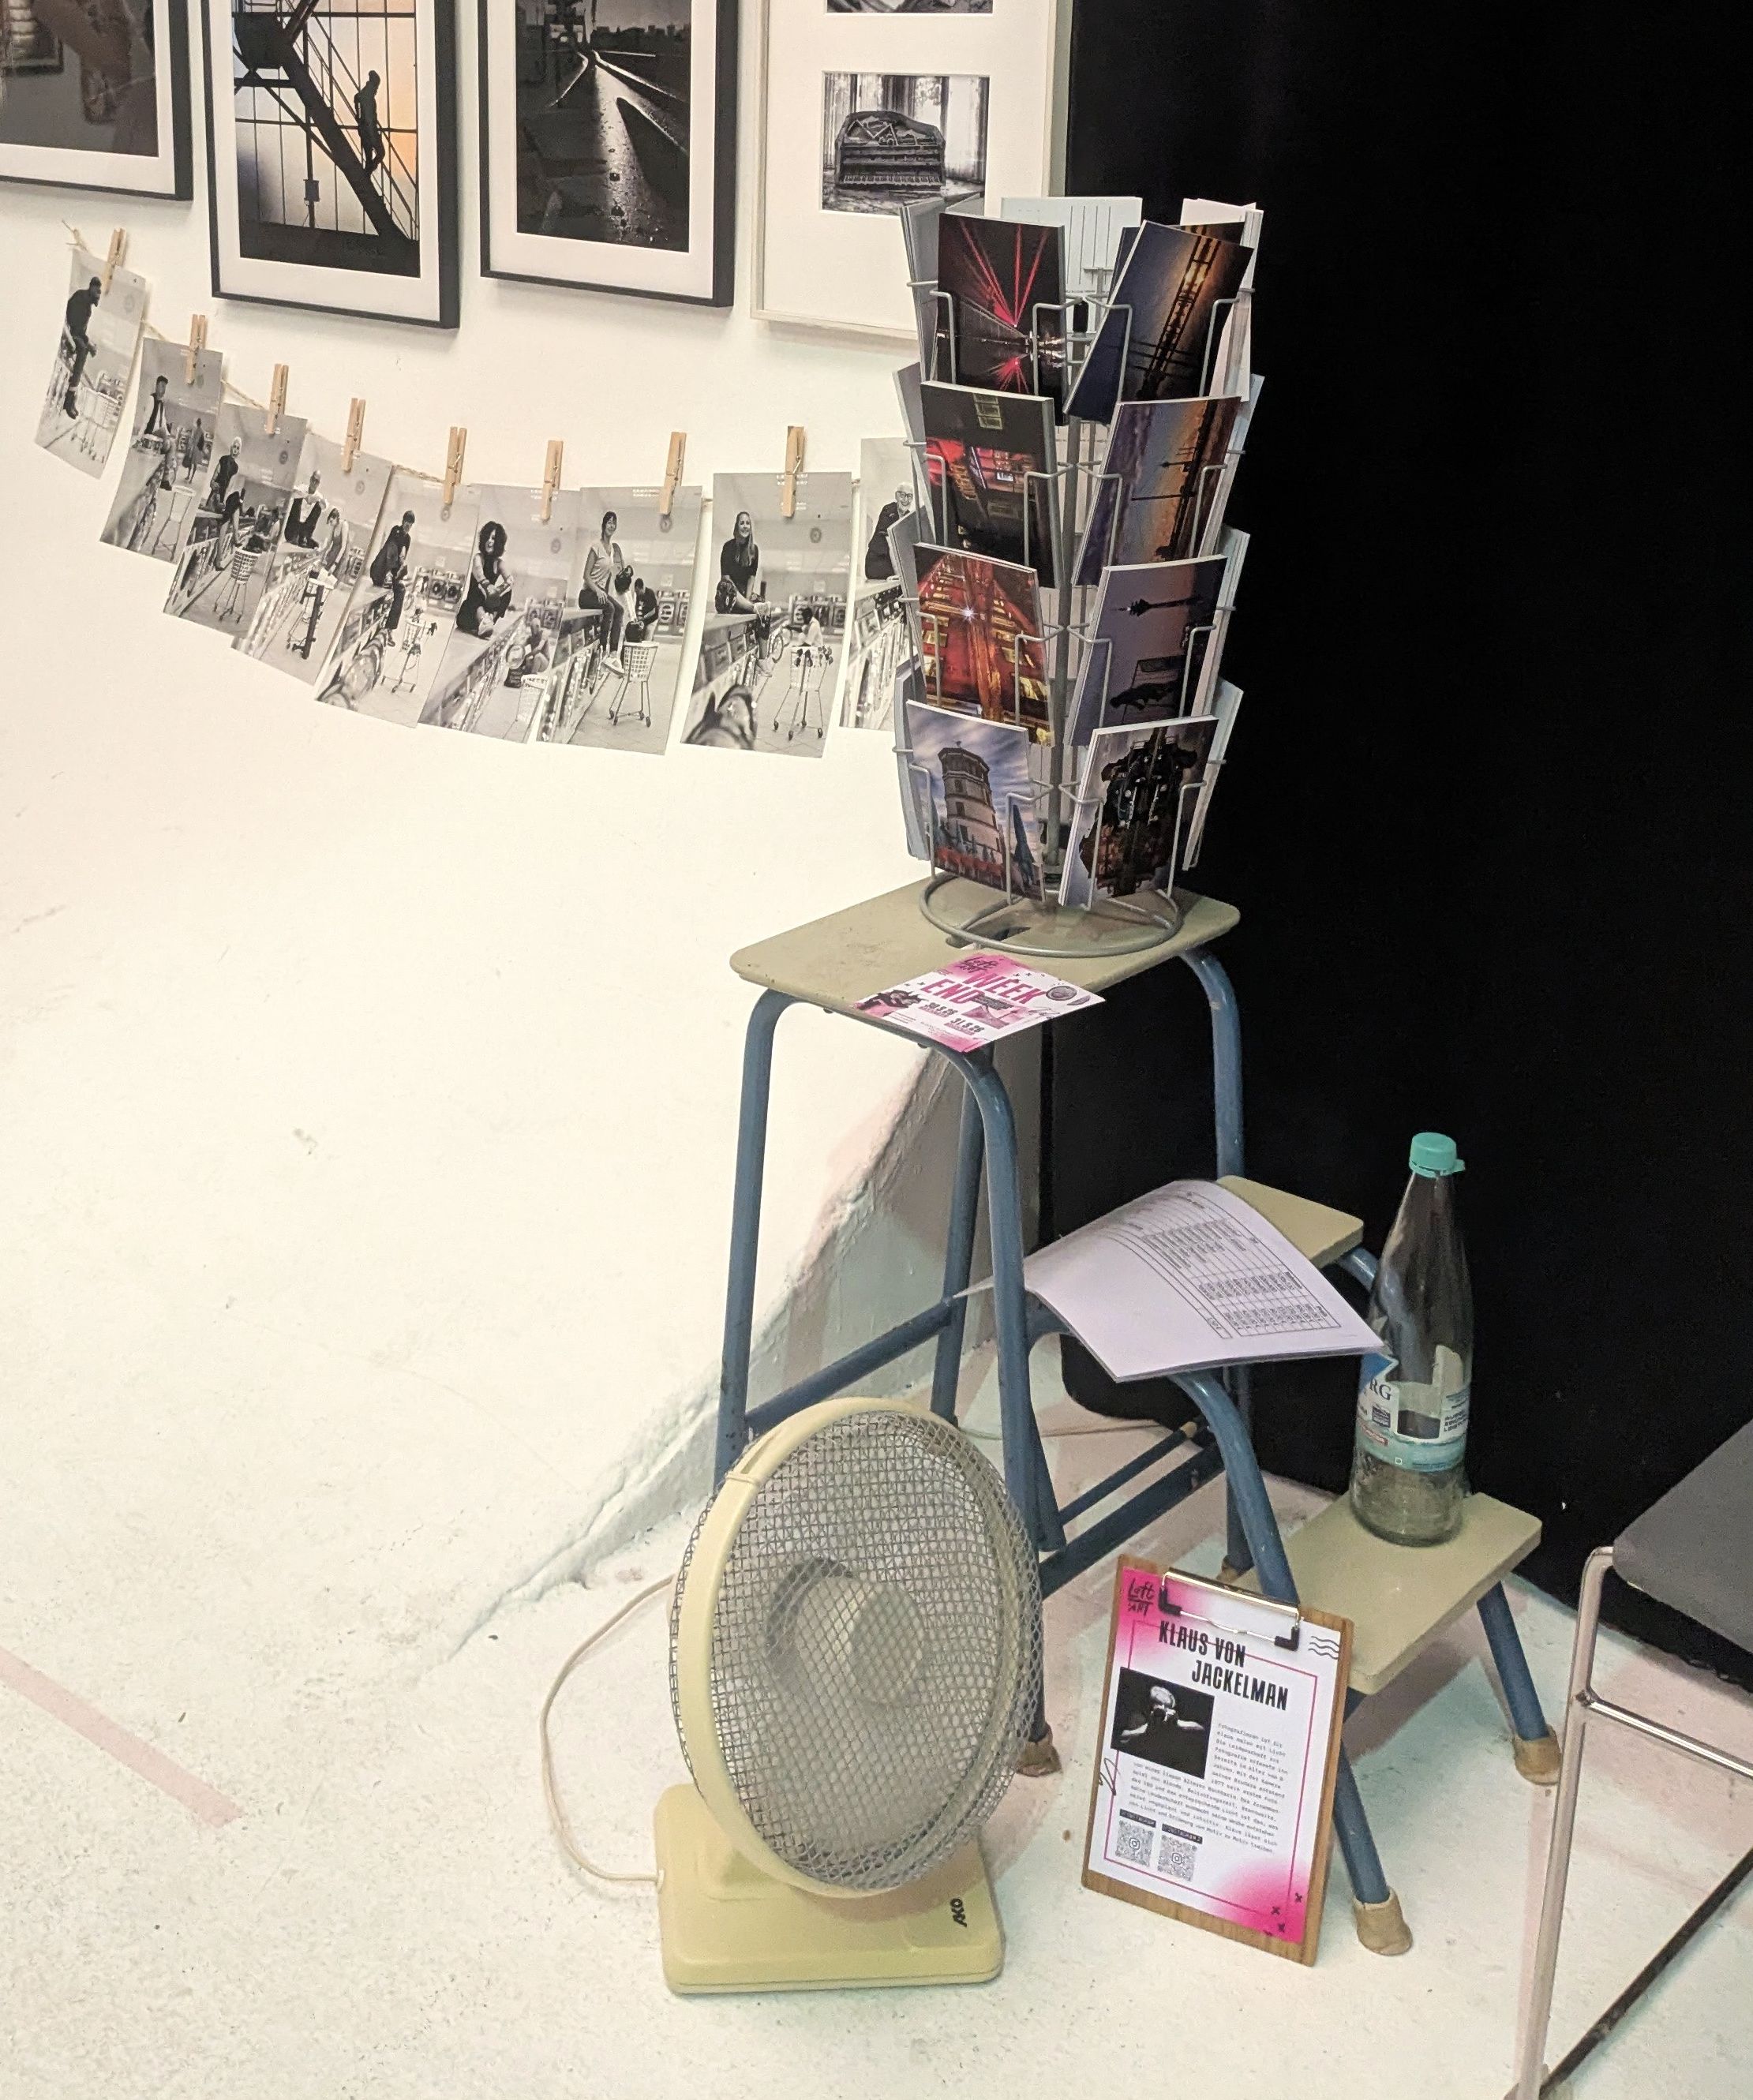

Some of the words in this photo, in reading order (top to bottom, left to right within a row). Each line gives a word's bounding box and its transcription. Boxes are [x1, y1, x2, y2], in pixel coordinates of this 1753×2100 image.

[920, 979, 985, 1004] END
[962, 973, 1047, 1004] WEEK
[1159, 1620, 1208, 1656] KLAUS
[1215, 1637, 1245, 1668] VON
[1192, 1660, 1288, 1711] JACKELMAN
[950, 1898, 968, 1928] AKO
